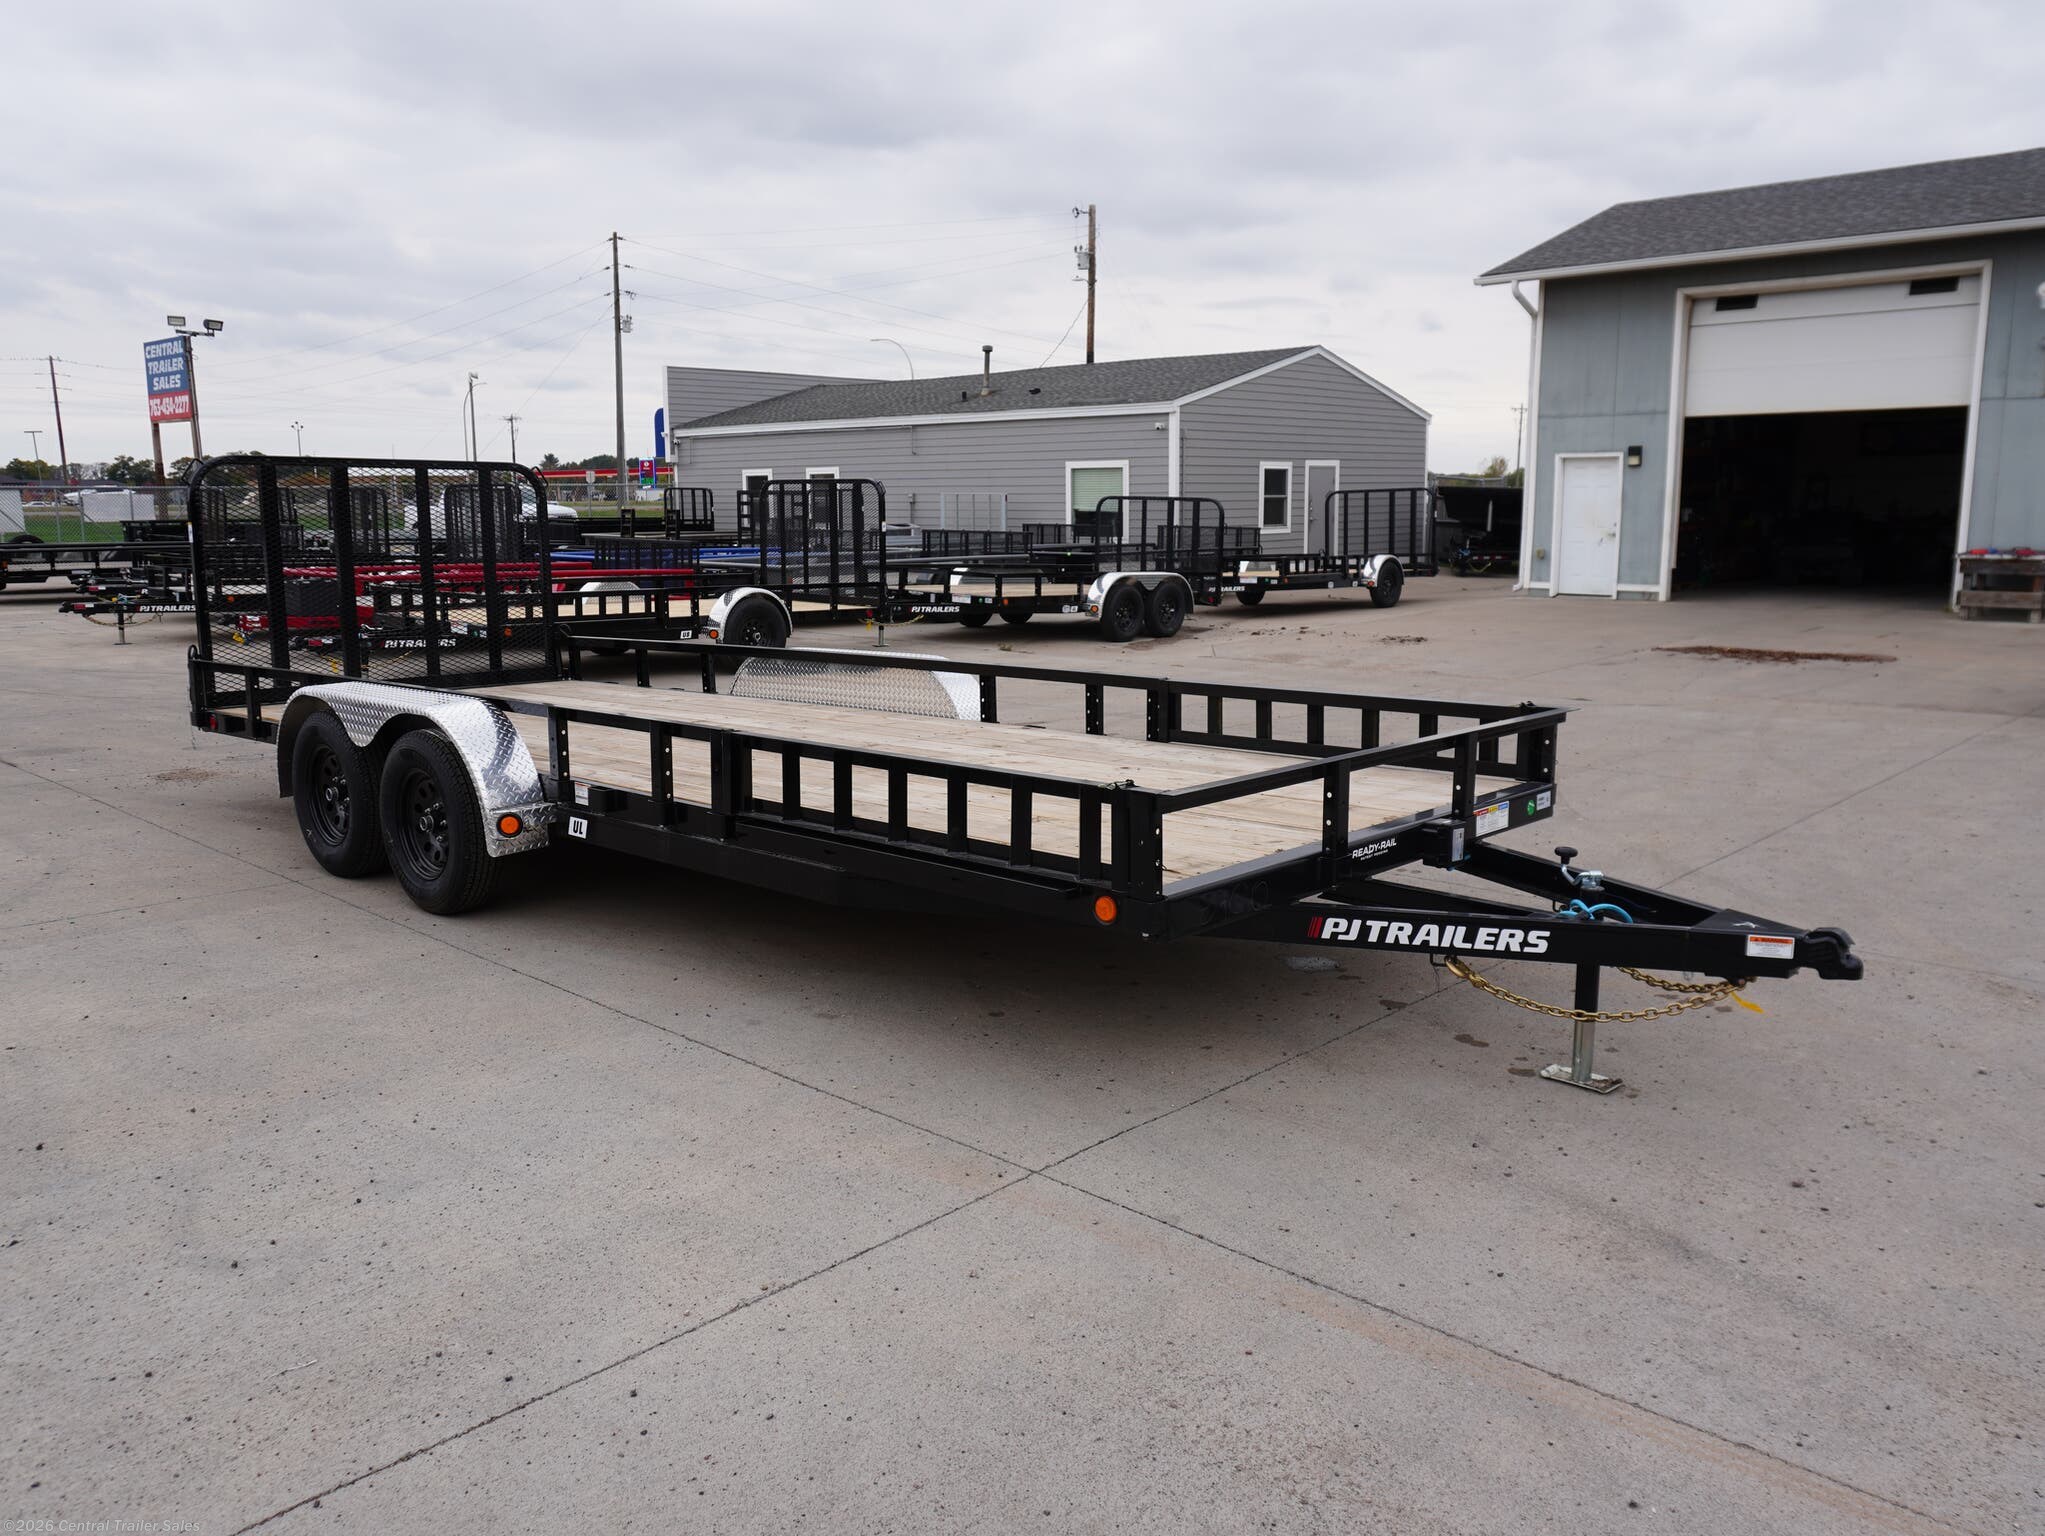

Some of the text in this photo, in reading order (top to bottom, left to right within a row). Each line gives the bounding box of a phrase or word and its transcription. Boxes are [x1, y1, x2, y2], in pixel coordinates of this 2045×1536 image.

[146, 340, 183, 358] CENTRAL
[147, 357, 184, 375] TRAILER
[153, 374, 181, 390] SALES
[911, 605, 960, 613] PJ TRAILERS
[573, 820, 583, 835] UL
[1321, 917, 1551, 954] PJ TRAILERS
